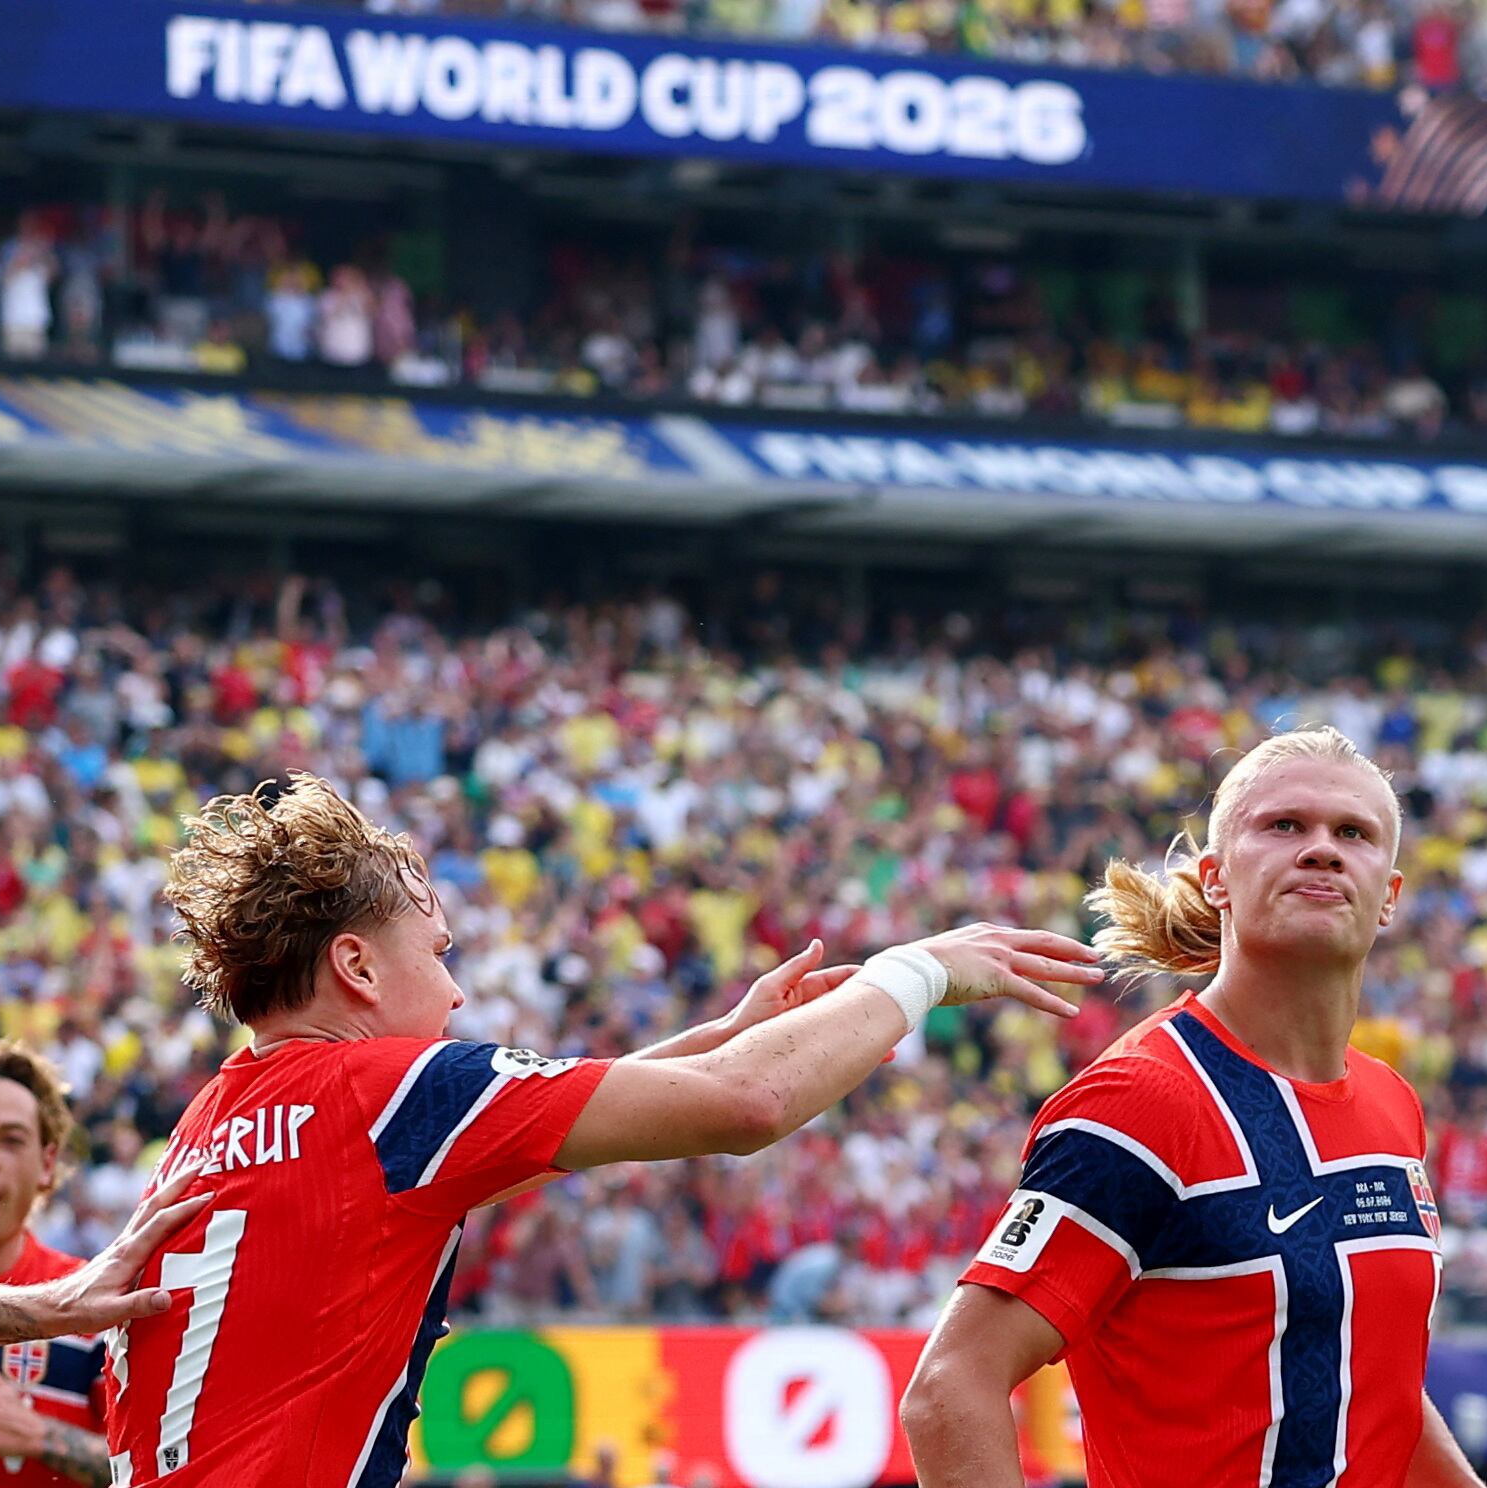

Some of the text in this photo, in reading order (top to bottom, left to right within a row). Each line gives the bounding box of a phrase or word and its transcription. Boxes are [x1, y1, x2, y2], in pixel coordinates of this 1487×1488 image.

[165, 14, 1087, 166] FIFA WORLD CUP 2026
